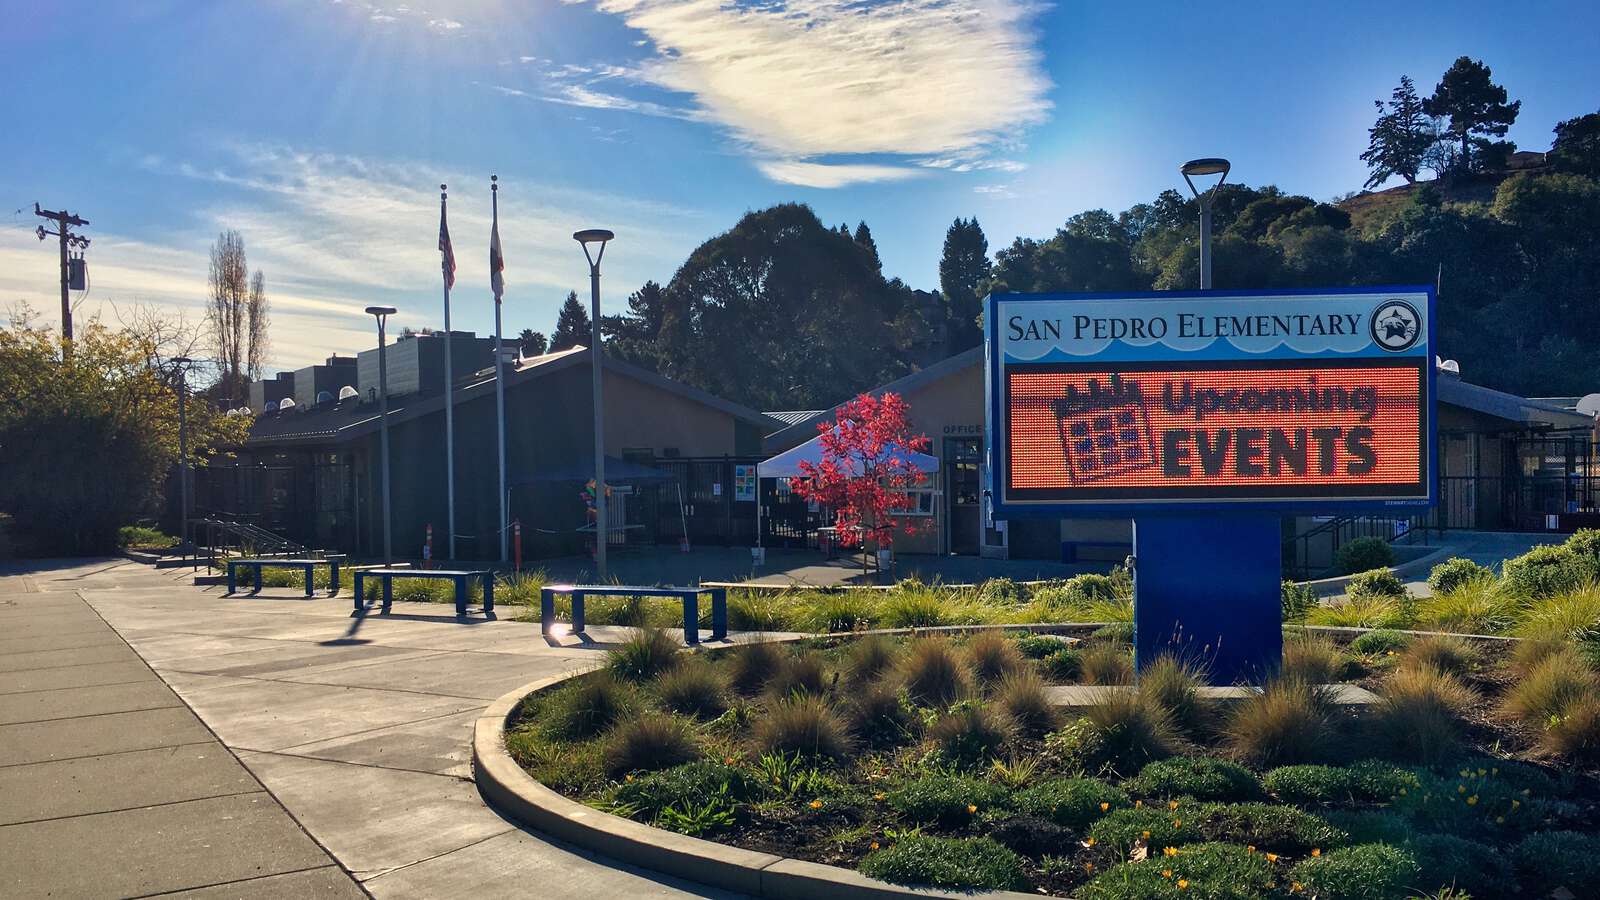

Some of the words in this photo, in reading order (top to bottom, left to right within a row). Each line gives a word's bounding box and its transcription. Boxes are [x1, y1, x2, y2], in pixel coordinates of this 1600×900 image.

[1008, 315, 1061, 341] SAN
[1072, 315, 1168, 339] PEDRO
[1177, 313, 1362, 338] ELEMENTARY
[1163, 376, 1377, 420] Upcoming
[943, 424, 983, 434] OFFICE
[1163, 427, 1377, 477] EVENTS
